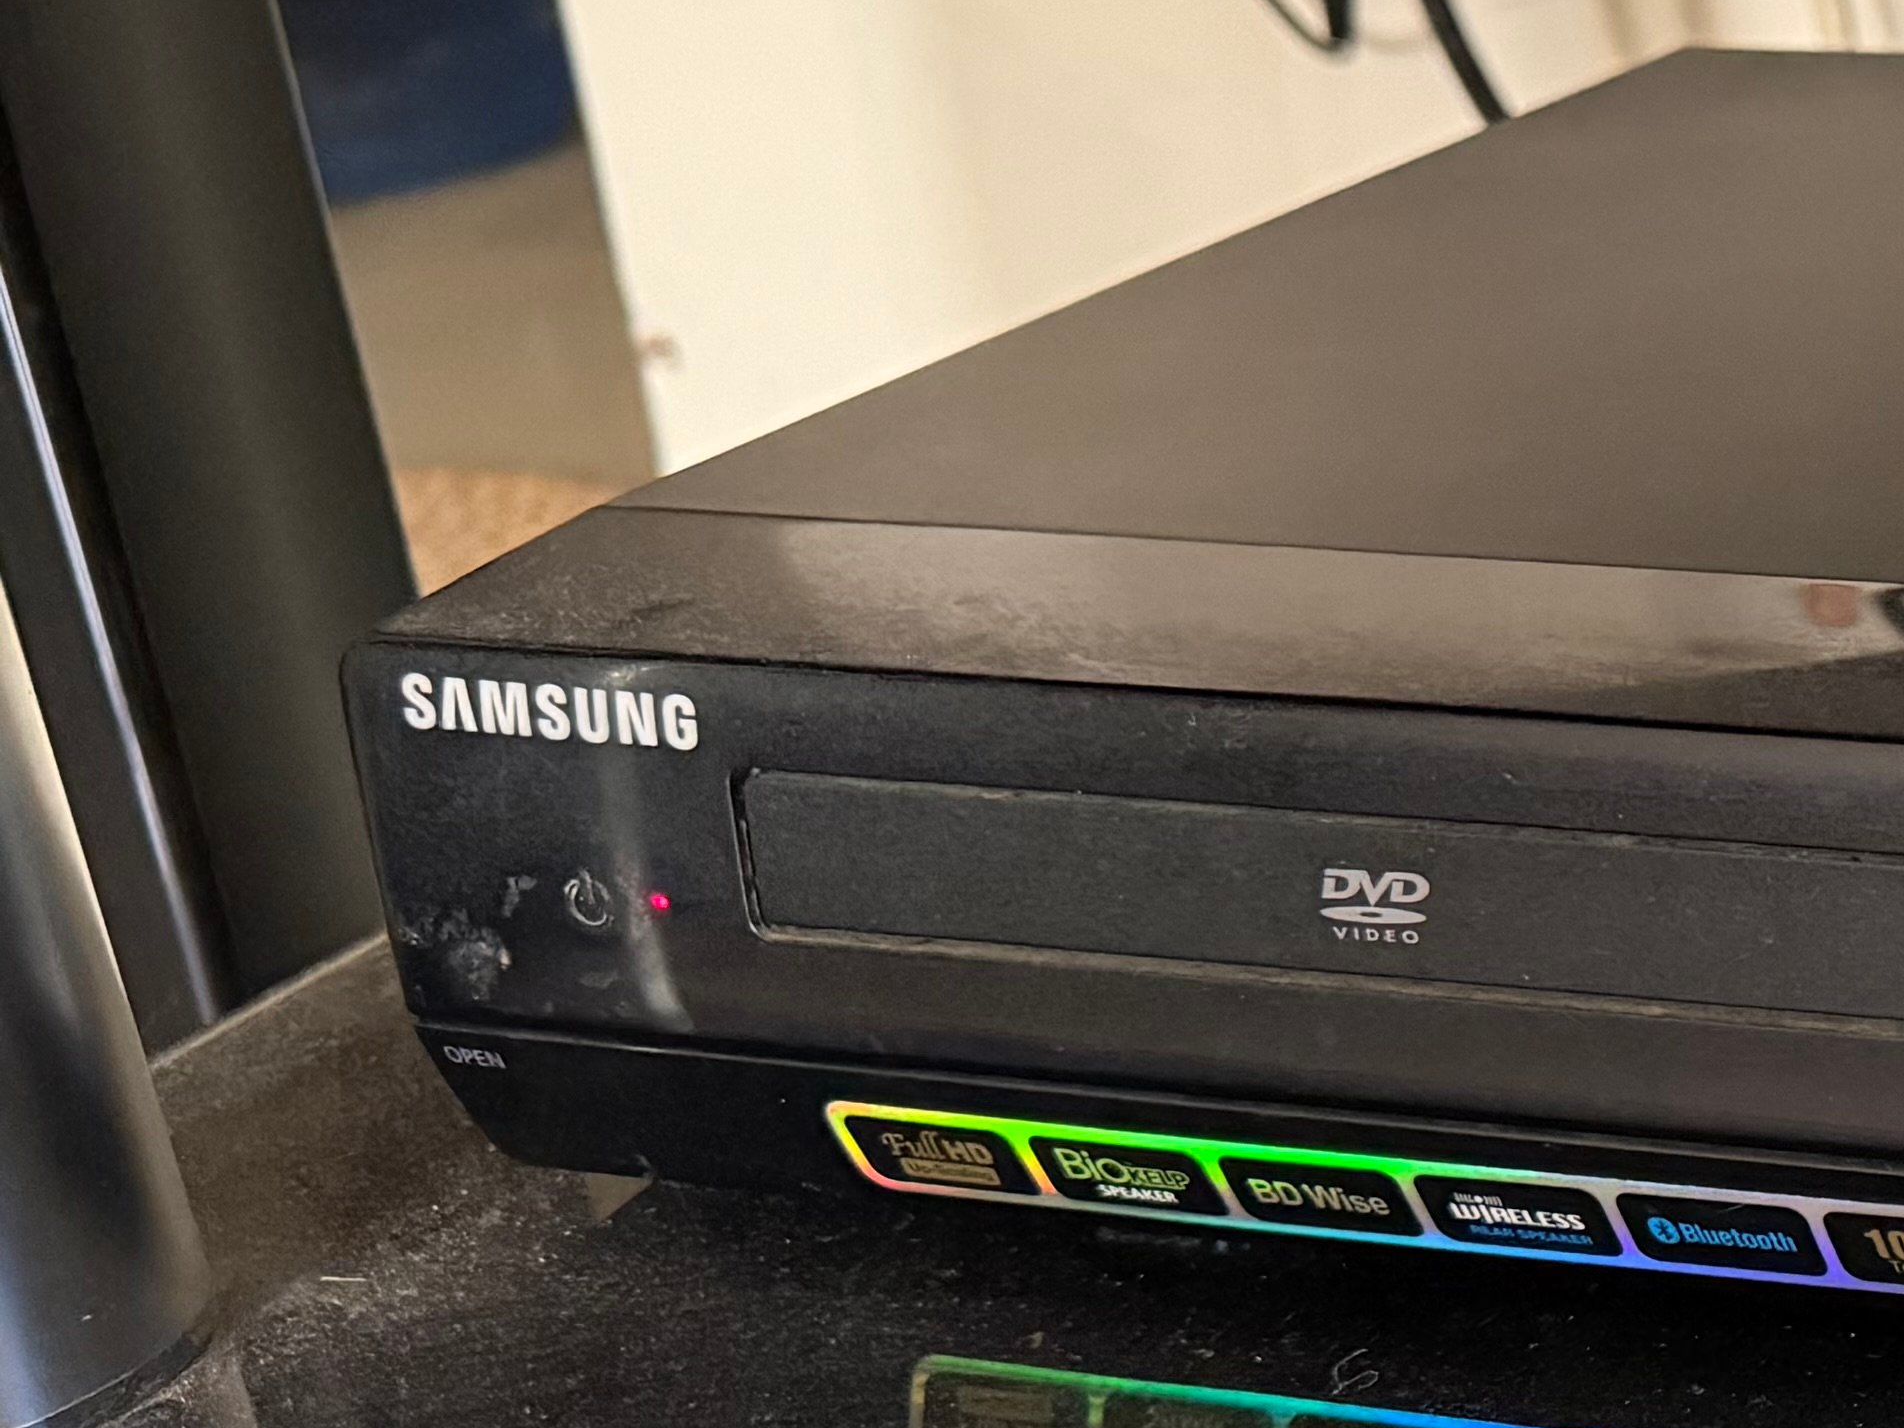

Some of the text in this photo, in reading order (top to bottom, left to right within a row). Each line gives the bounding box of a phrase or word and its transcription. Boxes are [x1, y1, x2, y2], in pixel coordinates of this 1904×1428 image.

[401, 672, 699, 751] SAMSUNG
[1321, 868, 1431, 907] DVD
[1332, 925, 1420, 944] VIDEO
[443, 1045, 507, 1069] OPEN
[881, 1130, 994, 1166] Full HD
[1096, 1184, 1180, 1204] SPEAKER
[1247, 1178, 1390, 1215] BD Wise
[1678, 1222, 1798, 1252] Bluetooth
